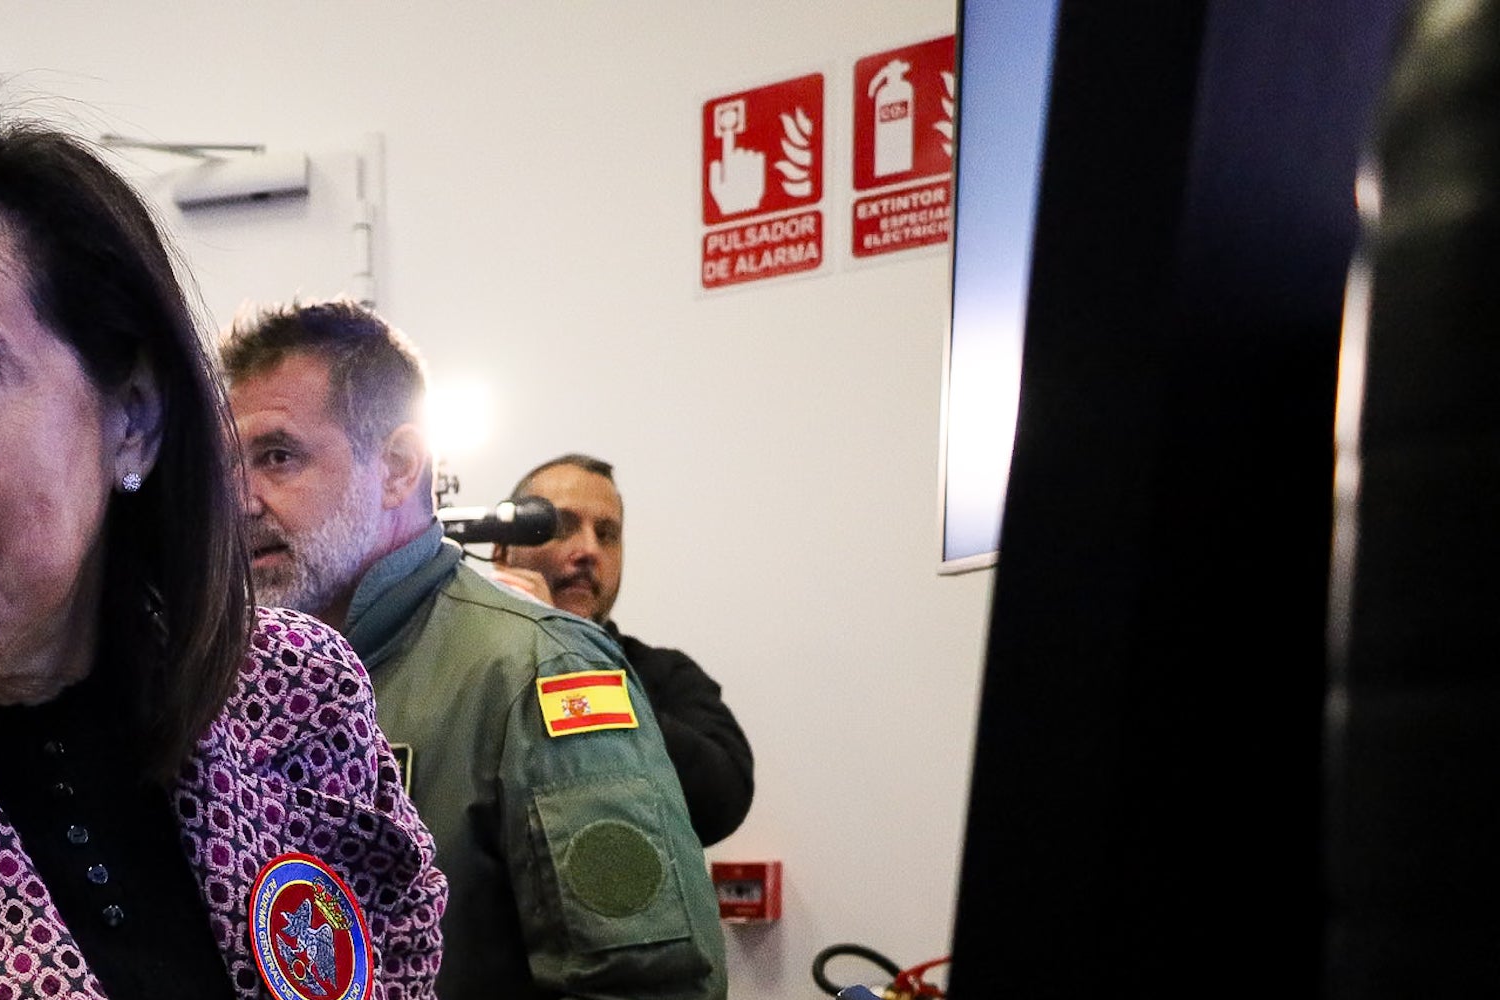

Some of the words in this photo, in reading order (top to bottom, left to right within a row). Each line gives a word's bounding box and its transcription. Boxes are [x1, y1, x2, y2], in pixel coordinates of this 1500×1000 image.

[856, 187, 946, 219] EXTINTOR
[706, 215, 816, 255] PULSADOR
[703, 257, 730, 281] DE
[734, 242, 818, 275] ALARMA
[258, 878, 278, 928] ACADEMIA
[258, 931, 280, 986] GENERAL
